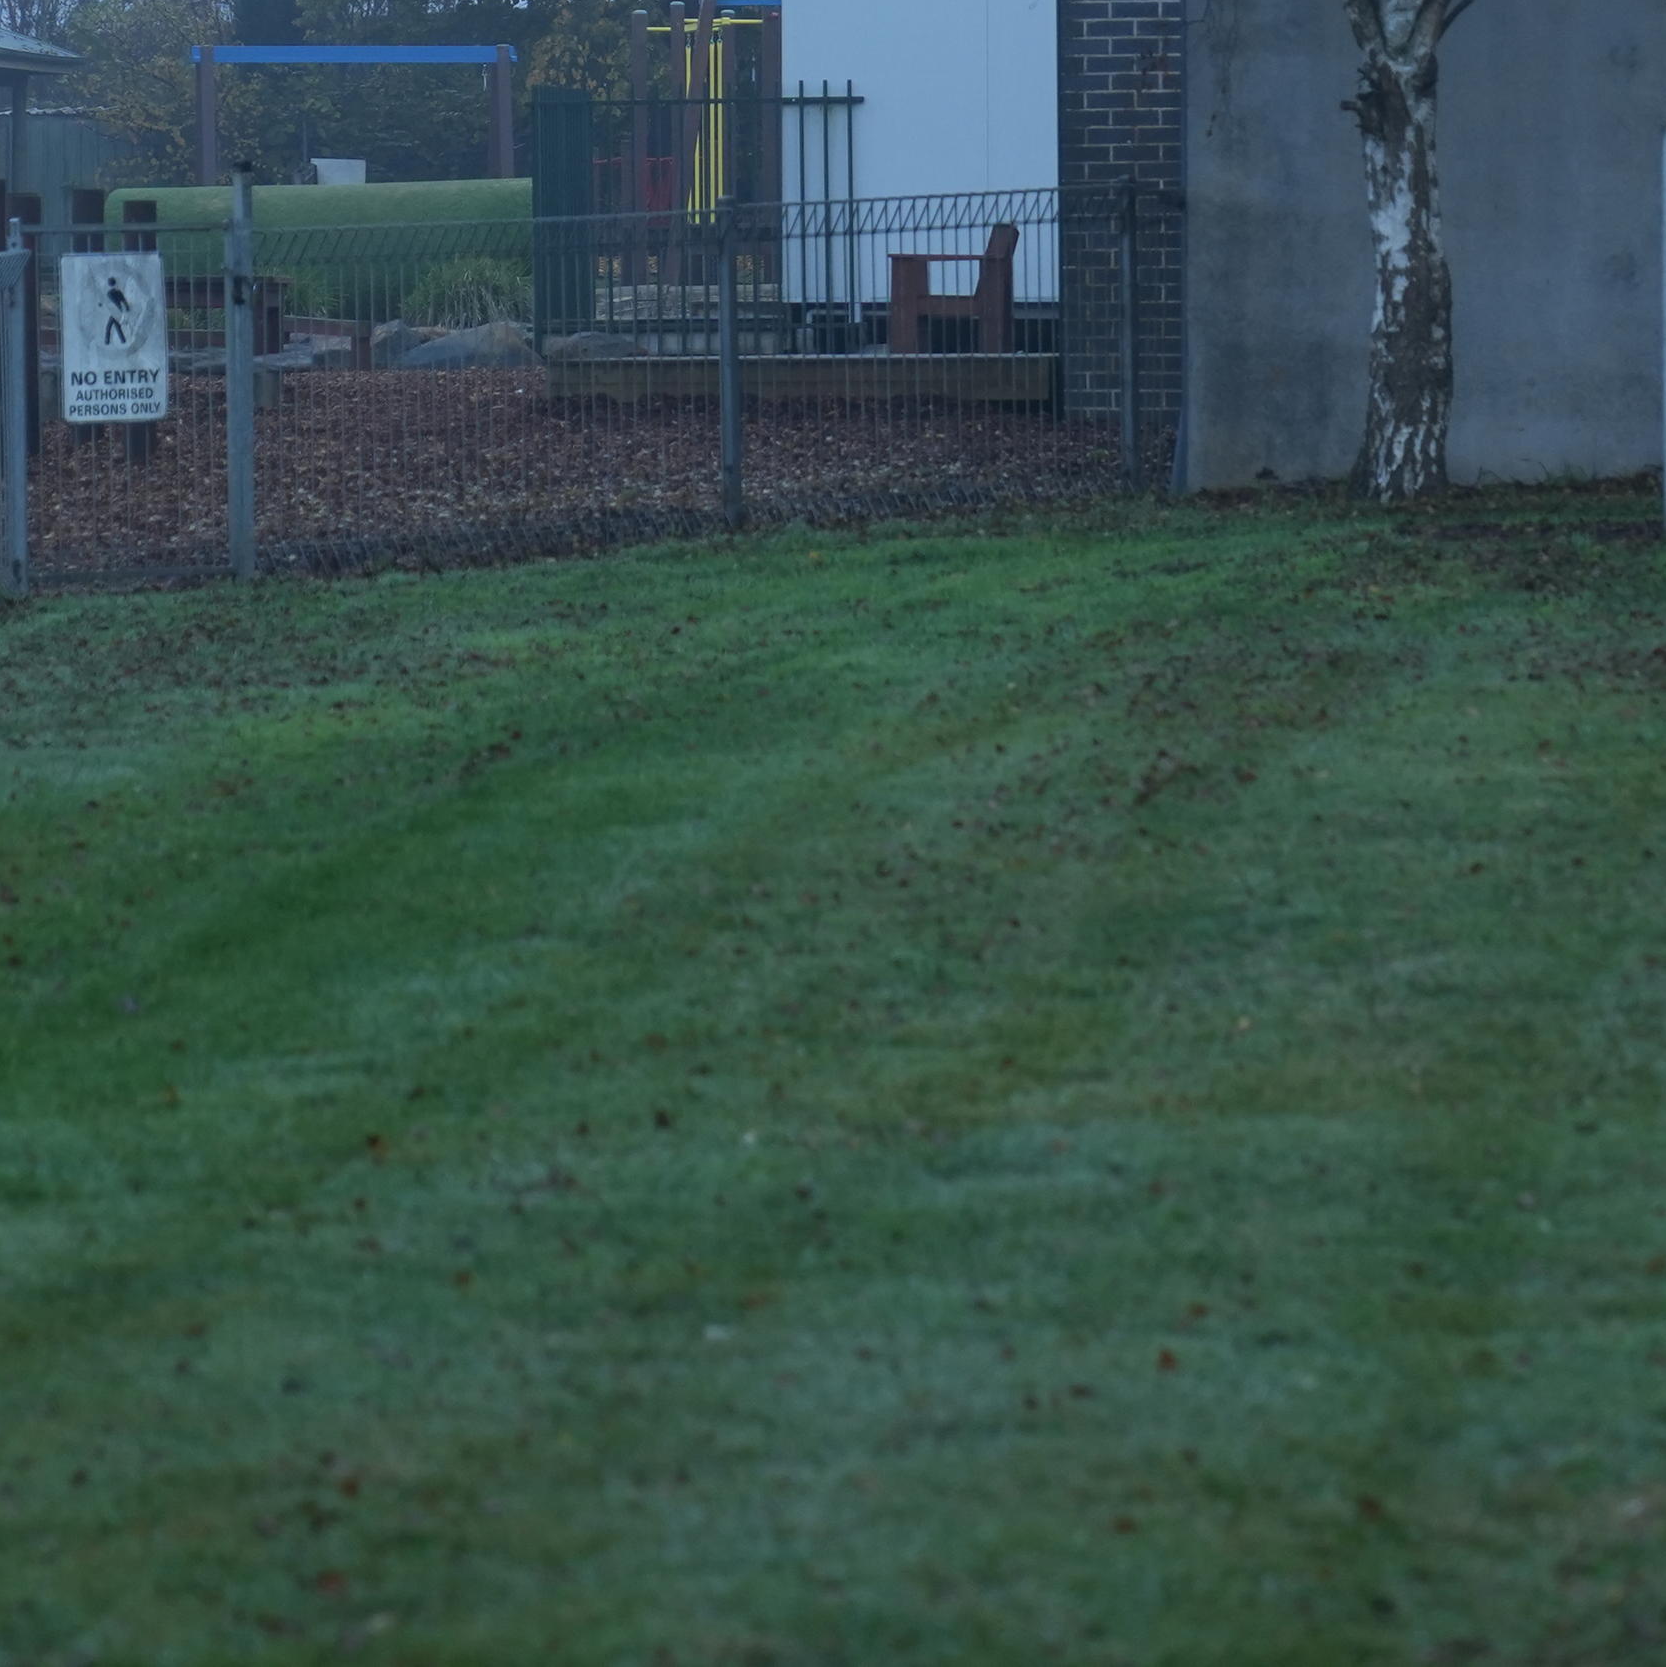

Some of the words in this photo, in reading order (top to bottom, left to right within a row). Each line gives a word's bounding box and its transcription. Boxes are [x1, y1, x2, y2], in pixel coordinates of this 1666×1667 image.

[71, 371, 97, 386] NO
[104, 368, 160, 384] ENTRY
[76, 387, 153, 401] AUTHORISED
[69, 403, 127, 416] PERSONS
[131, 402, 160, 414] ONLY
